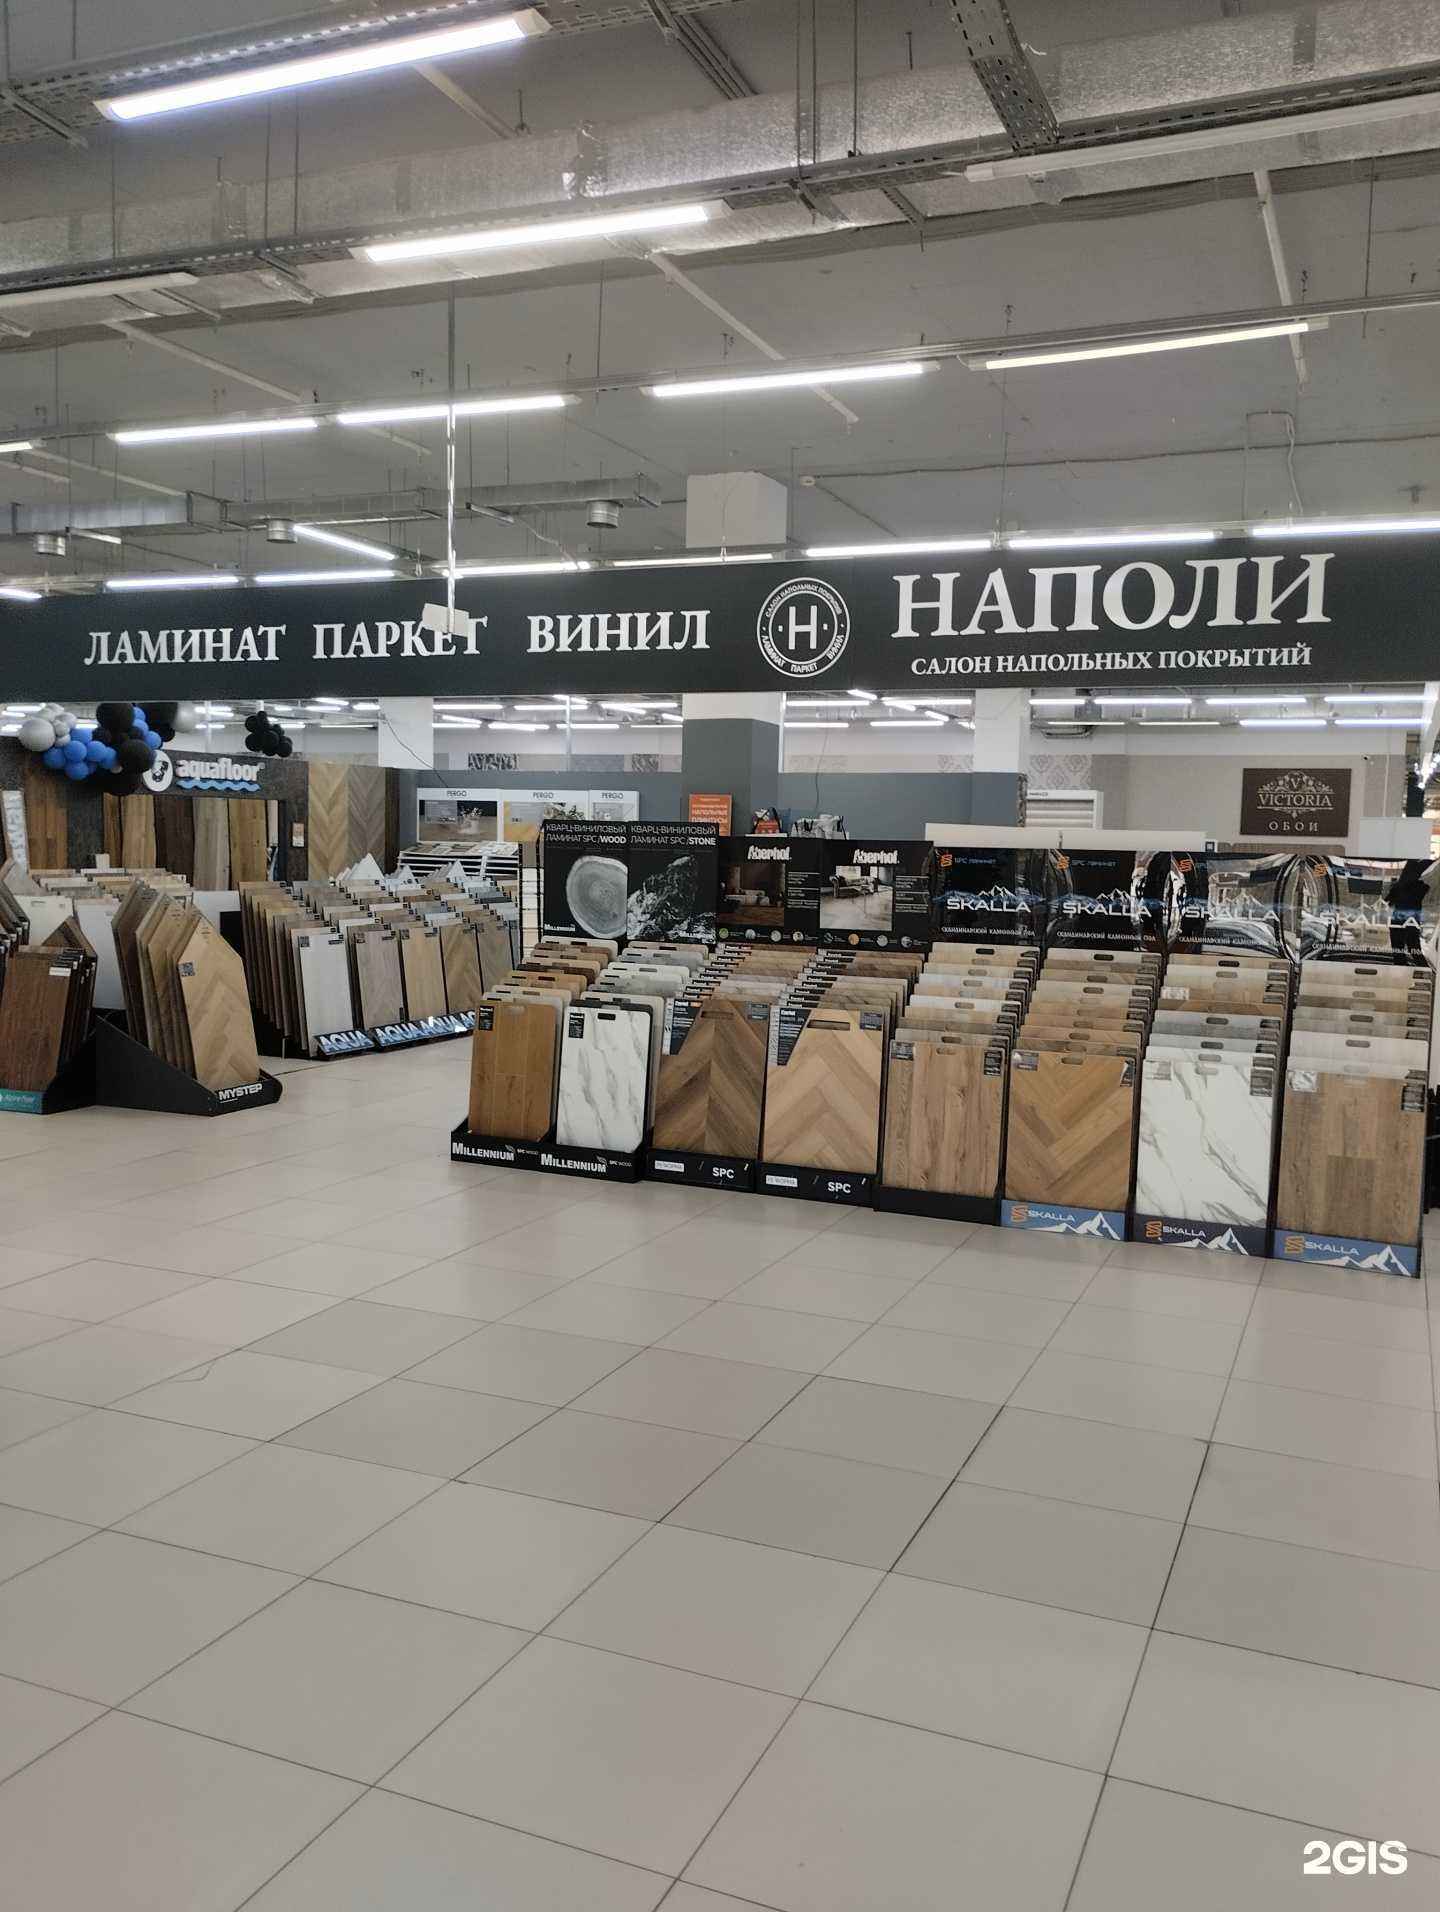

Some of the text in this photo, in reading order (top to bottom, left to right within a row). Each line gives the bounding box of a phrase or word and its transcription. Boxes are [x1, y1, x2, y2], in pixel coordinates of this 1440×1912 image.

[891, 553, 1336, 638] НАПОЛИ
[84, 609, 711, 667] ЛАМИНАТ ПАРКЕТ ВИНИЛ
[910, 642, 1312, 676] САЛОН НАПОЛЬНЫХ ПОКРЫТИЙ
[790, 661, 818, 674] ПАРКЕТ
[446, 790, 467, 798] PERGO
[532, 791, 555, 799] PERGO
[601, 791, 624, 800] PERGO
[1258, 793, 1333, 807] VICTORIA
[545, 823, 627, 834] КВАРЦ-ВИНИЛОВЫЙ
[630, 825, 717, 835] КВАРЦ-ВИНИЛОВЫЙ
[1268, 820, 1319, 832] ОБОИ
[546, 833, 582, 843] ЛАМИНАТ
[582, 834, 597, 843] SPC
[630, 835, 669, 845] ЛАМИНАТ
[671, 836, 686, 845] SPC
[946, 898, 1032, 913] SKALLA
[1062, 902, 1152, 918] SKALLA
[1184, 909, 1282, 923] SKALLA
[1319, 911, 1424, 929] SKALLA
[375, 1022, 422, 1045] AQUA
[319, 1029, 374, 1053] AQUA
[218, 1082, 263, 1101] MYSTEP
[712, 1166, 735, 1180] SPC
[827, 1180, 851, 1194] SPC
[1027, 1208, 1076, 1223] SKALLA
[1161, 1223, 1207, 1238] SKALLA
[1303, 1240, 1360, 1256] SKALLA
